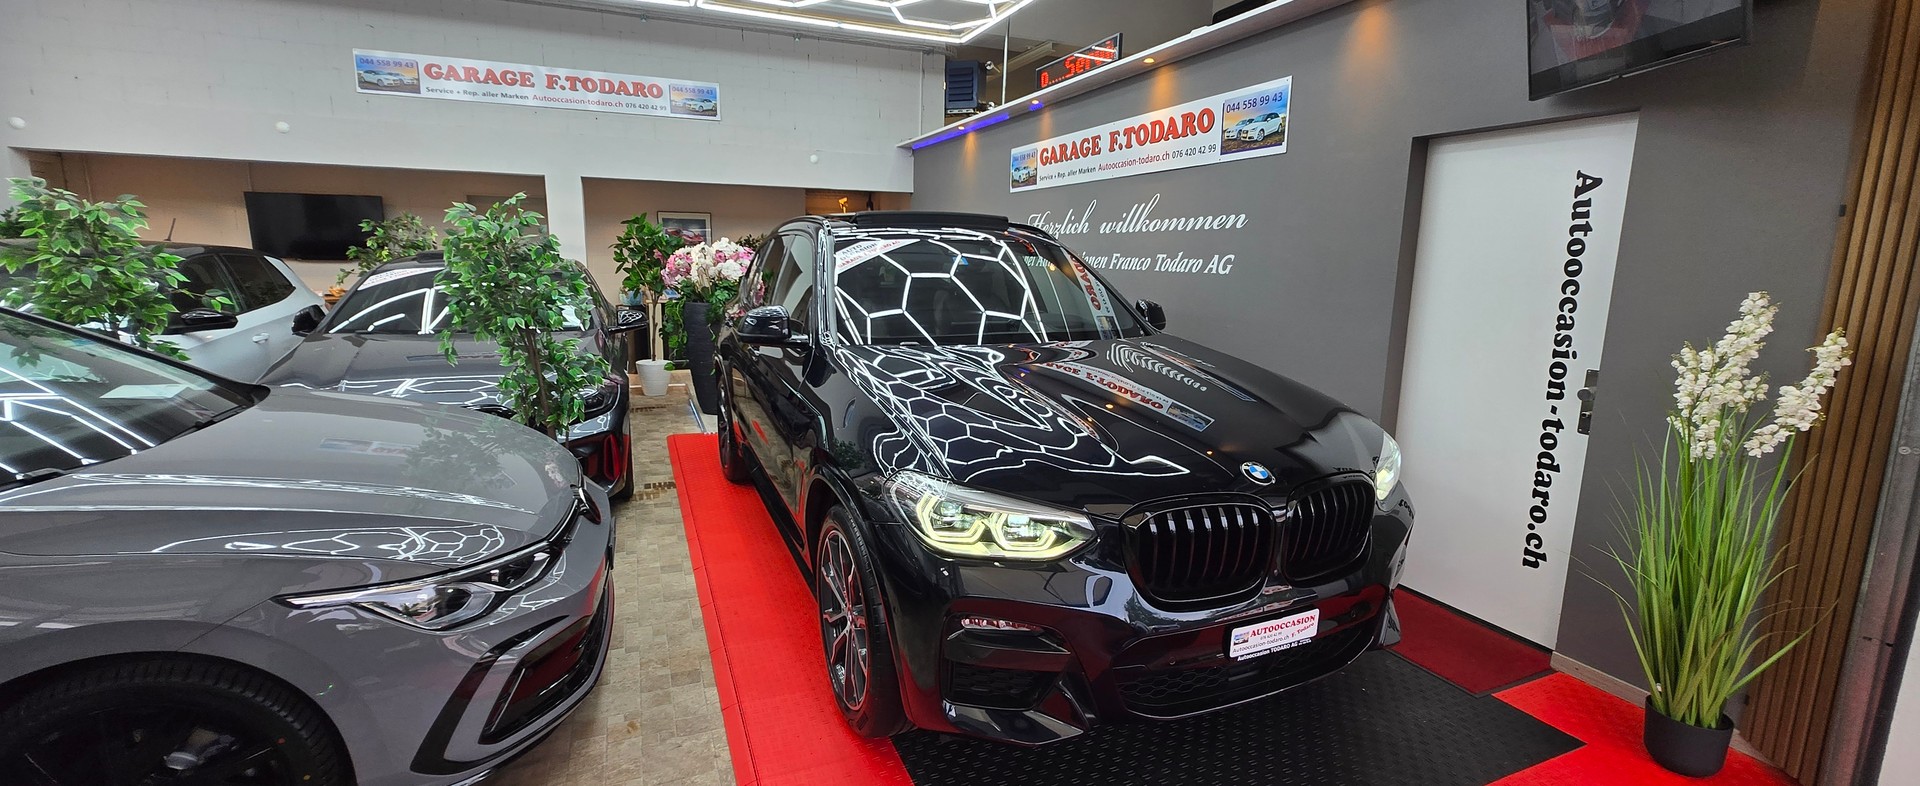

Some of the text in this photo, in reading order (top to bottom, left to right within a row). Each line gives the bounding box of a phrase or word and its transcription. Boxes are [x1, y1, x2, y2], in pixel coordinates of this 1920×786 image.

[359, 57, 414, 69] 044 558 99 43
[423, 63, 664, 99] GARAGE F.TODARO
[532, 94, 624, 108] Autooccasion-todaro.ch
[1226, 92, 1283, 114] 044 558 99 43
[1040, 107, 1215, 166] GARAGE F.TODARO
[1067, 169, 1078, 177] aller
[1078, 167, 1096, 175] Marken
[1098, 151, 1170, 171] Autooccasion-todaro.ch
[1171, 150, 1183, 159] 076
[1184, 147, 1196, 156] 420
[1198, 145, 1206, 154] 42
[1208, 144, 1216, 153] 99
[1027, 193, 1248, 240] Herzlich willkommen
[1109, 253, 1151, 271] Franco
[1154, 251, 1203, 273] Todaro
[1203, 254, 1235, 275] AG
[1522, 169, 1604, 570] Autooccasion-todaro.ch
[1250, 614, 1316, 638] AUTOOCCASION
[1237, 649, 1271, 661] Autooccasion
[1271, 643, 1291, 653] TODARO
